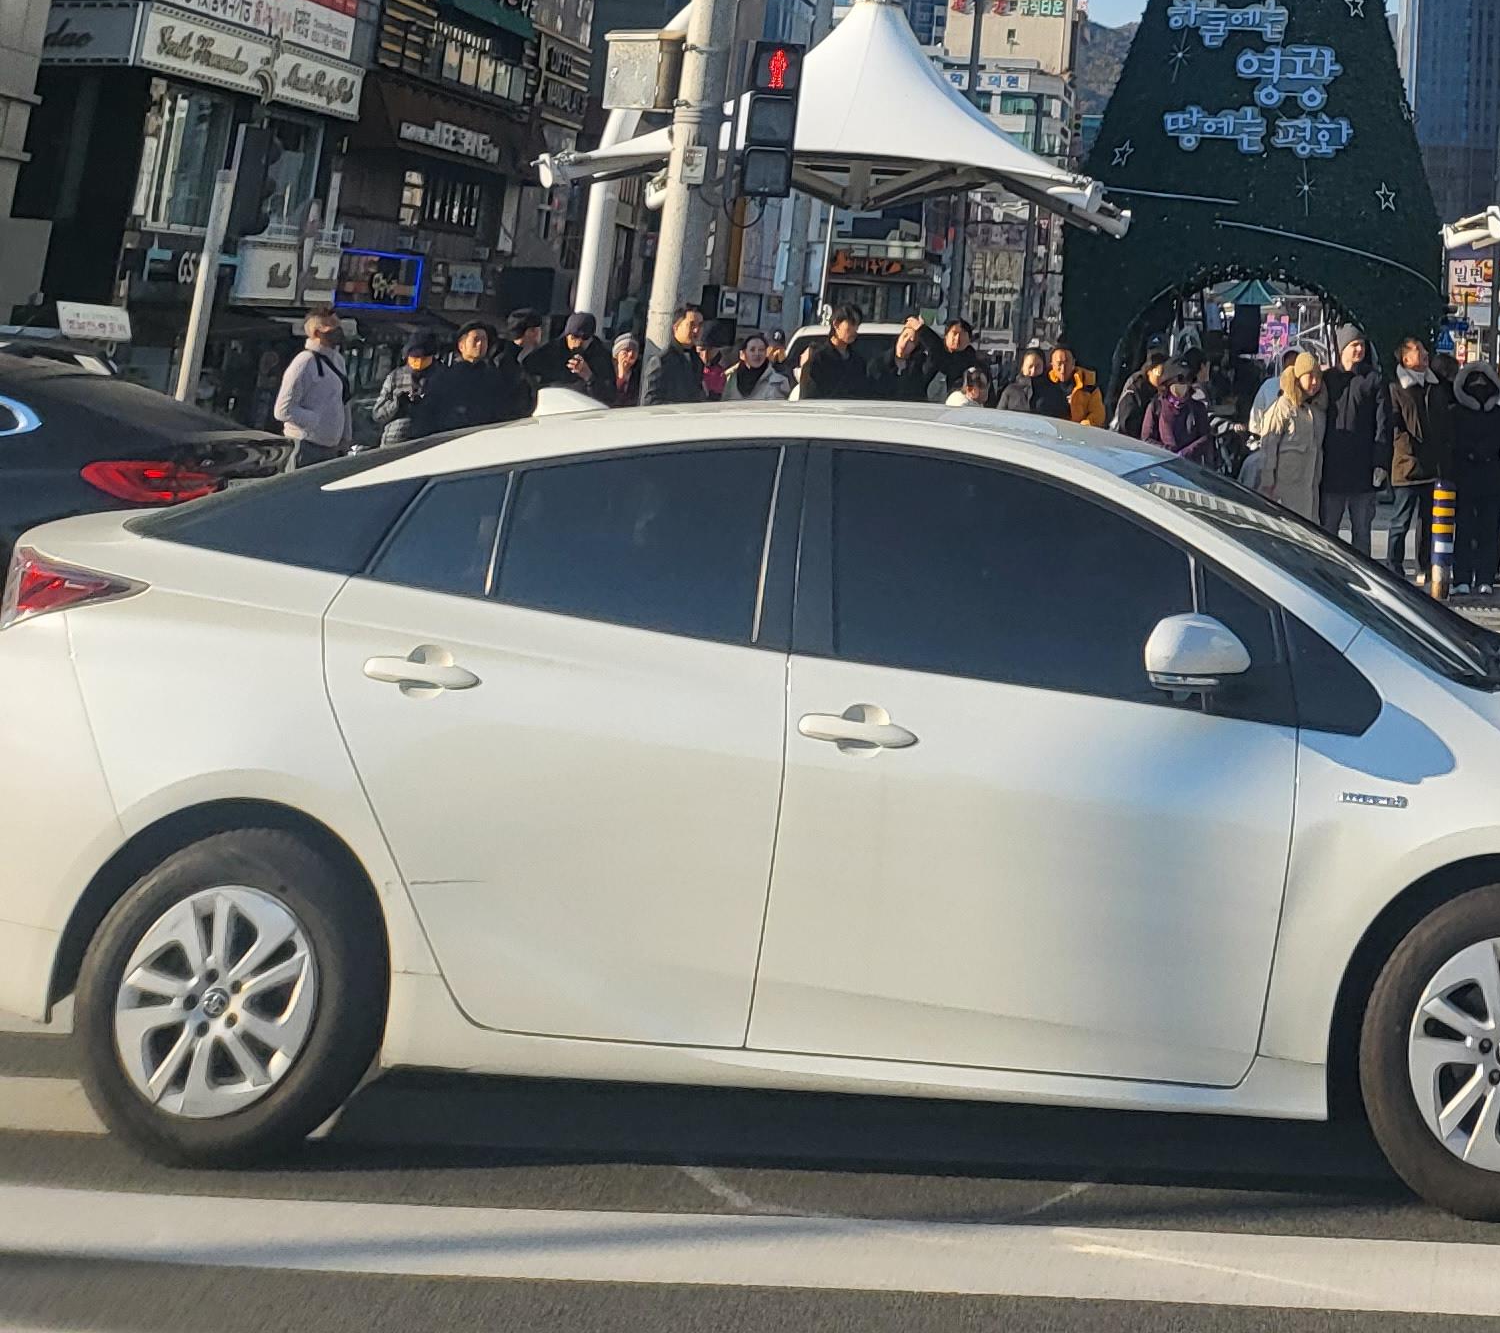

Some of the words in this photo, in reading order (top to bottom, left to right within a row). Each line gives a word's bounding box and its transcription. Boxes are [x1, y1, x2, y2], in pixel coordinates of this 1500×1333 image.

[1236, 44, 1344, 110] 영광
[1163, 105, 1267, 154] 땅에는
[1271, 112, 1353, 158] 평화
[1455, 265, 1483, 283] 밀면
